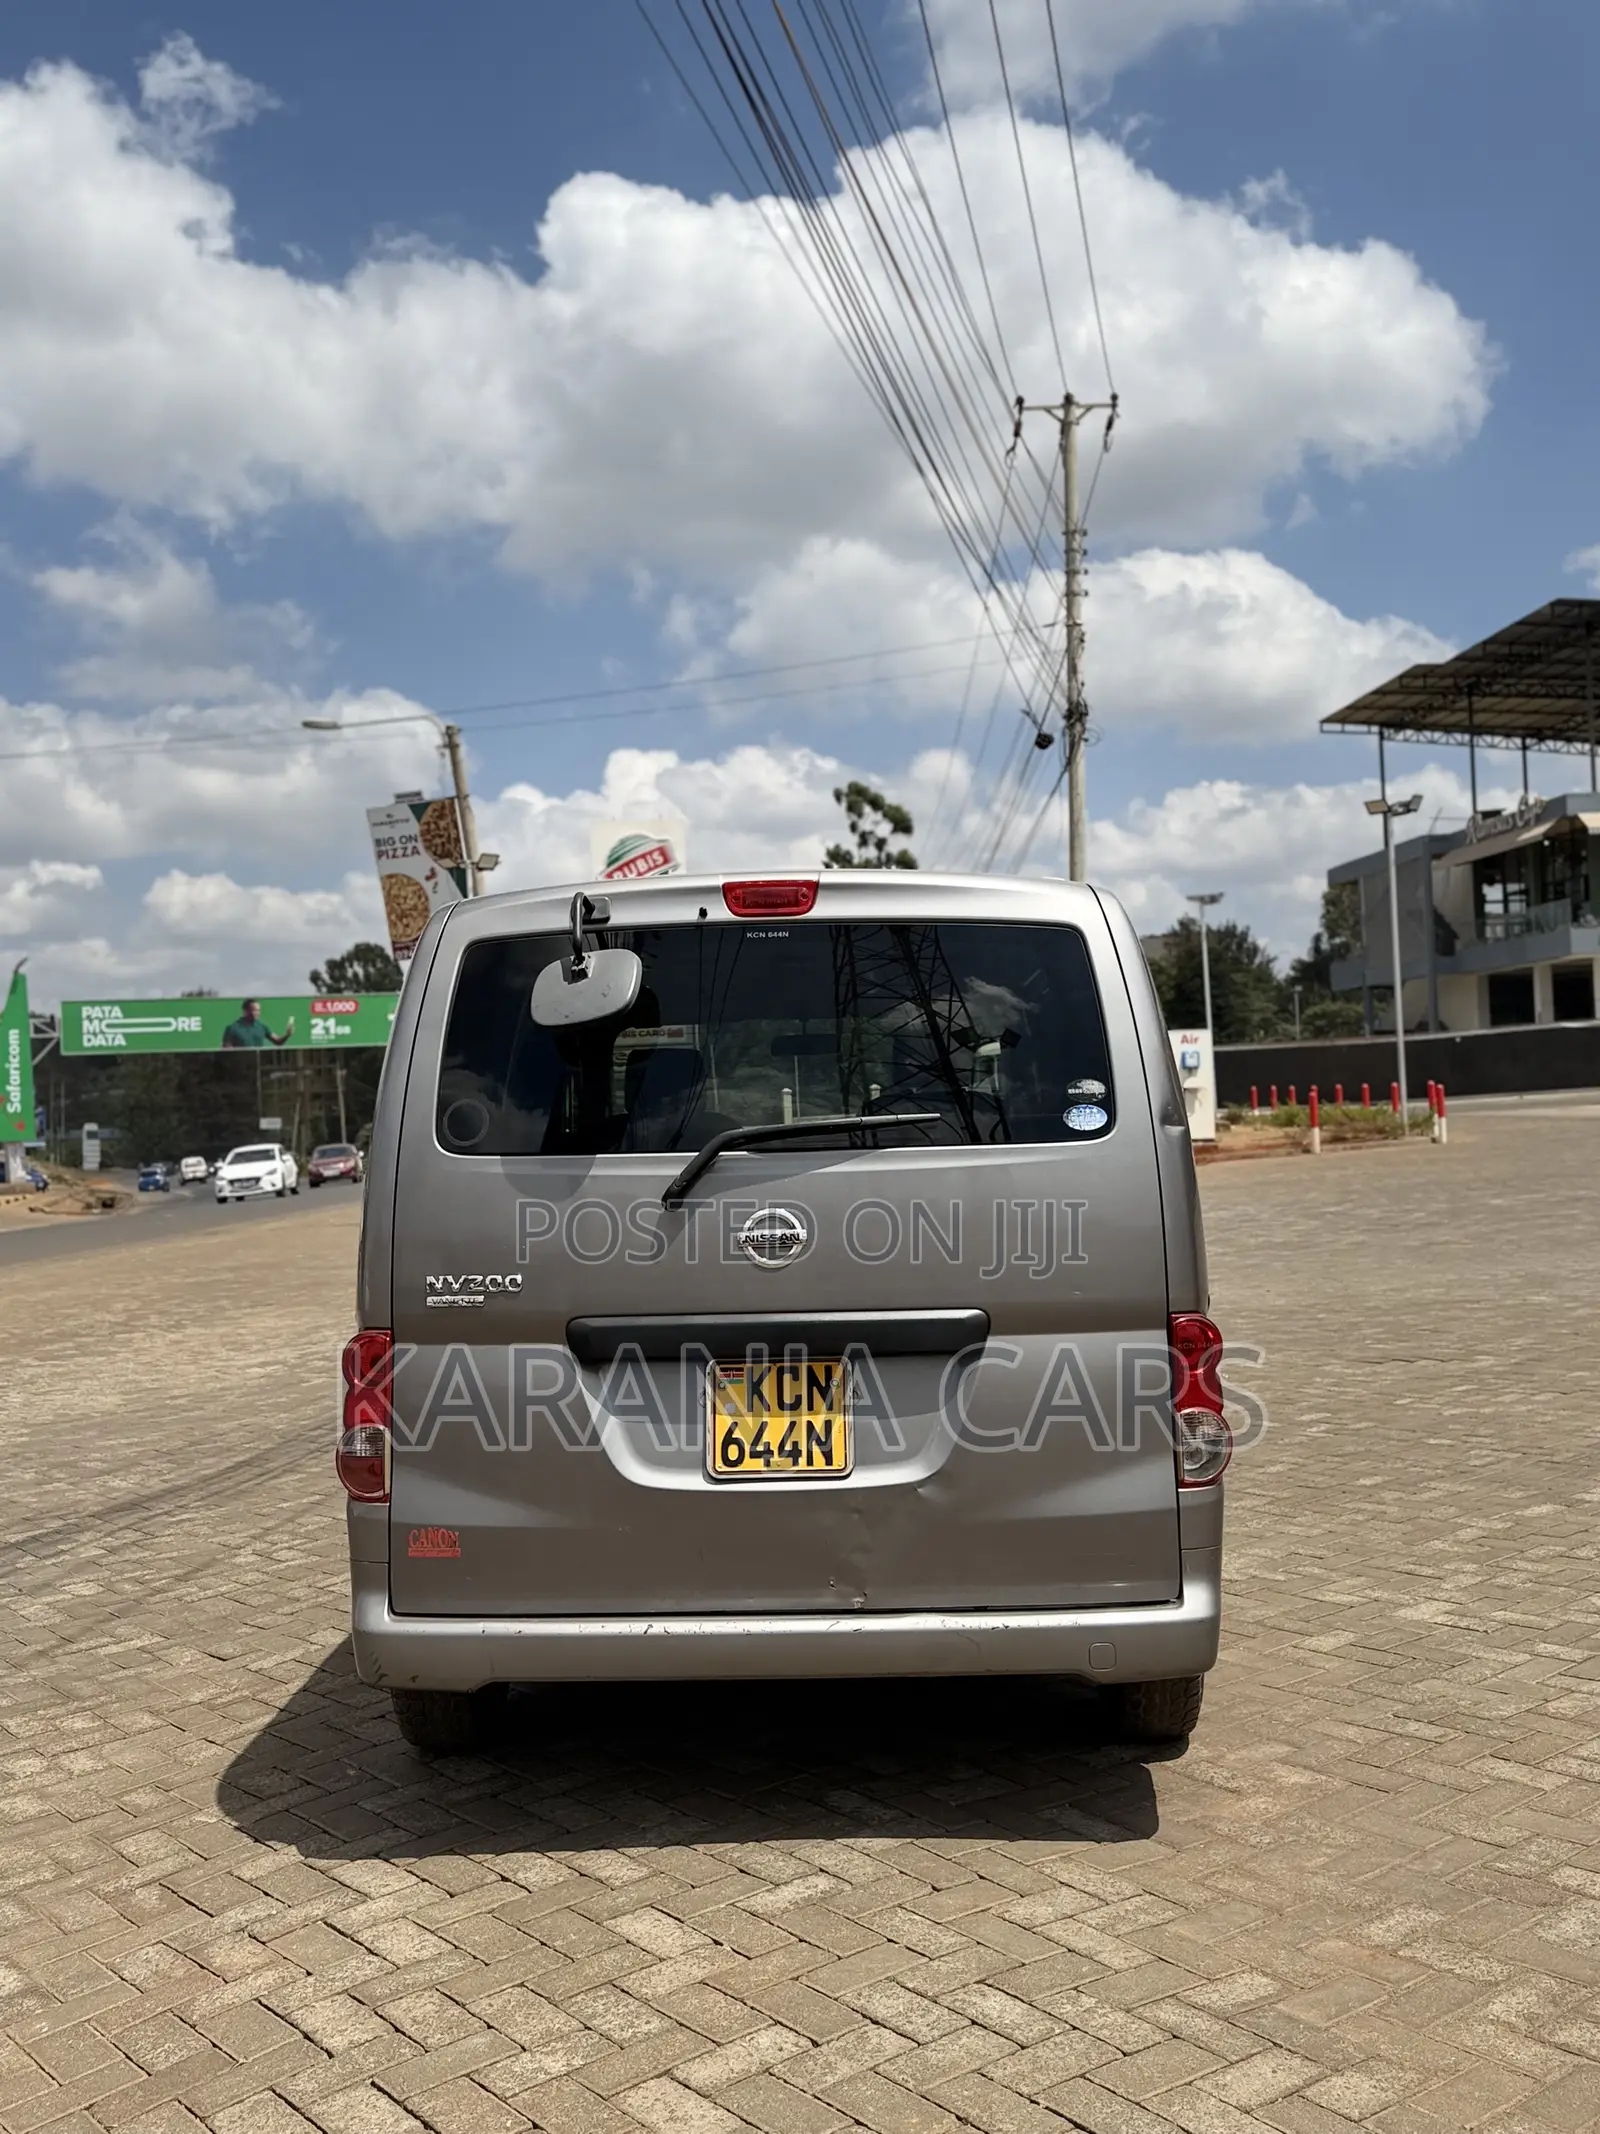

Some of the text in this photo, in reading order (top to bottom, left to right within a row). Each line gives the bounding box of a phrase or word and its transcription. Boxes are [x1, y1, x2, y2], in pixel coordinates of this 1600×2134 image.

[375, 834, 419, 848] BIG ON
[377, 845, 422, 861] PIZZA
[767, 930, 789, 938] 644N
[81, 1005, 124, 1019] PATA
[326, 1000, 357, 1013] 1,000
[310, 1017, 336, 1035] 21
[82, 1033, 127, 1047] DATA
[1180, 1033, 1200, 1045] Air
[4, 1028, 21, 1113] Safaricom
[744, 1233, 800, 1243] NISSAN
[425, 1274, 523, 1293] NV200
[746, 1364, 834, 1412] KCN
[720, 1419, 834, 1468] 644N
[408, 1526, 460, 1548] CANON
